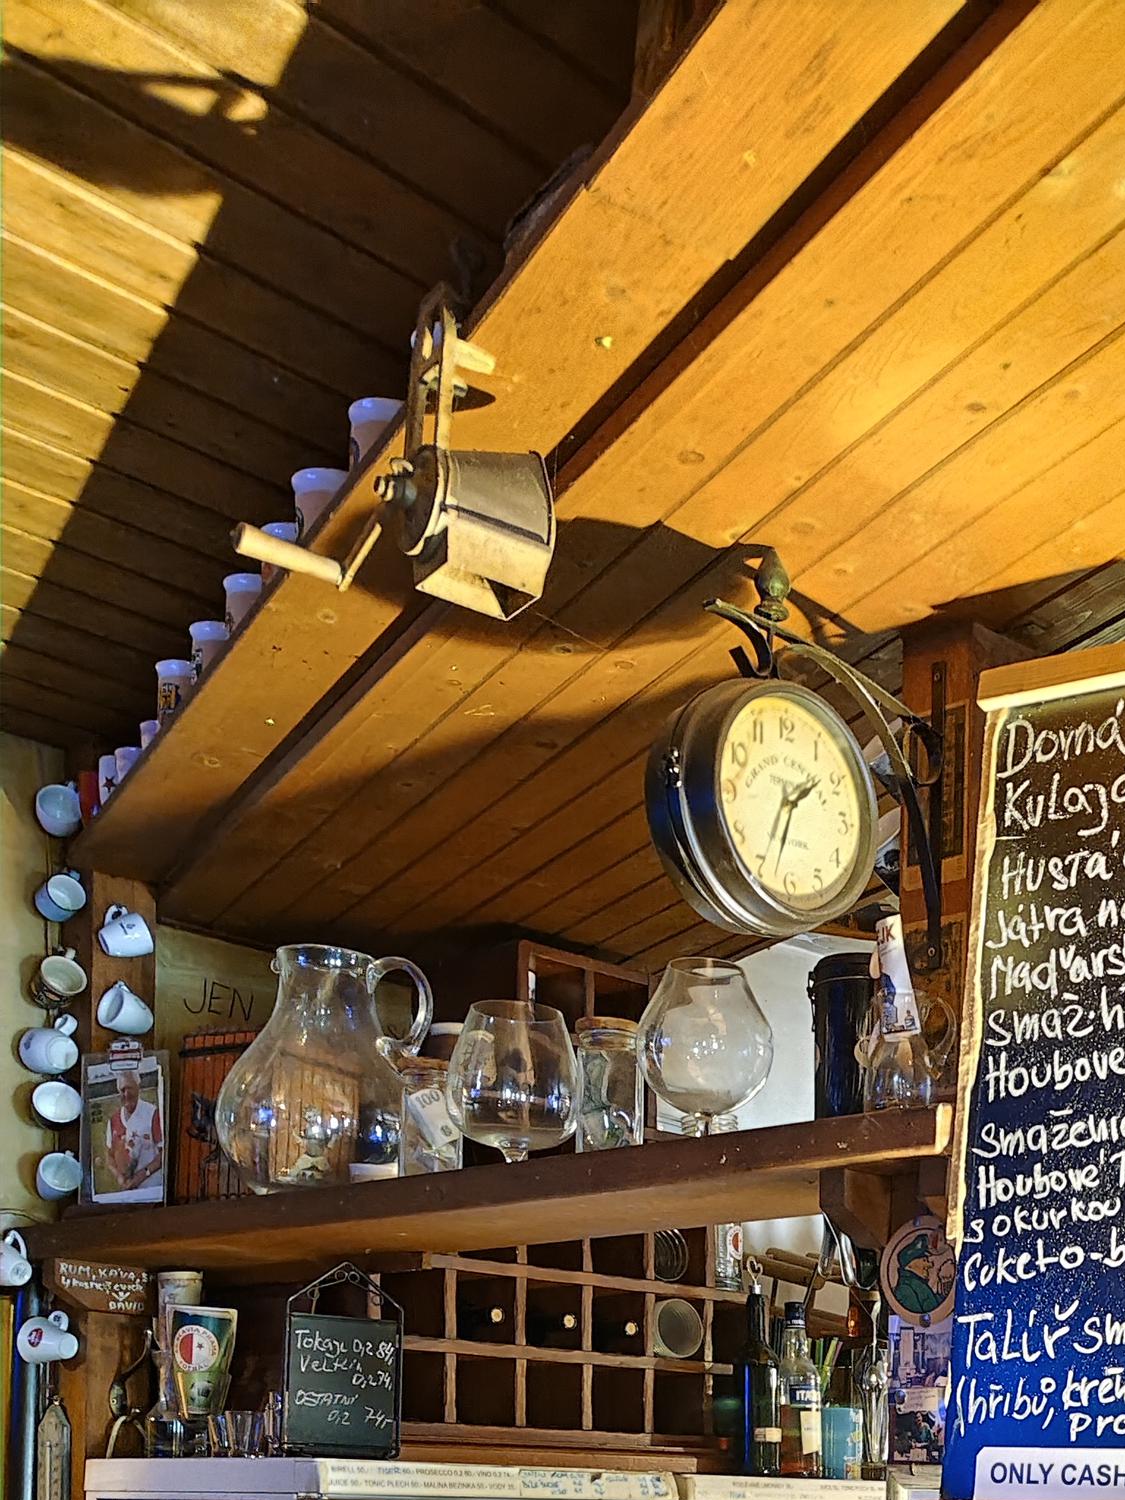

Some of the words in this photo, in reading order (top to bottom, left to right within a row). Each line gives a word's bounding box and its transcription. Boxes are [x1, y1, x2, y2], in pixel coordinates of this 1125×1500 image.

[779, 716, 795, 743] 12
[184, 976, 255, 1022] JEN
[328, 1409, 352, 1426] 0,2
[990, 1461, 1055, 1485] ONLY
